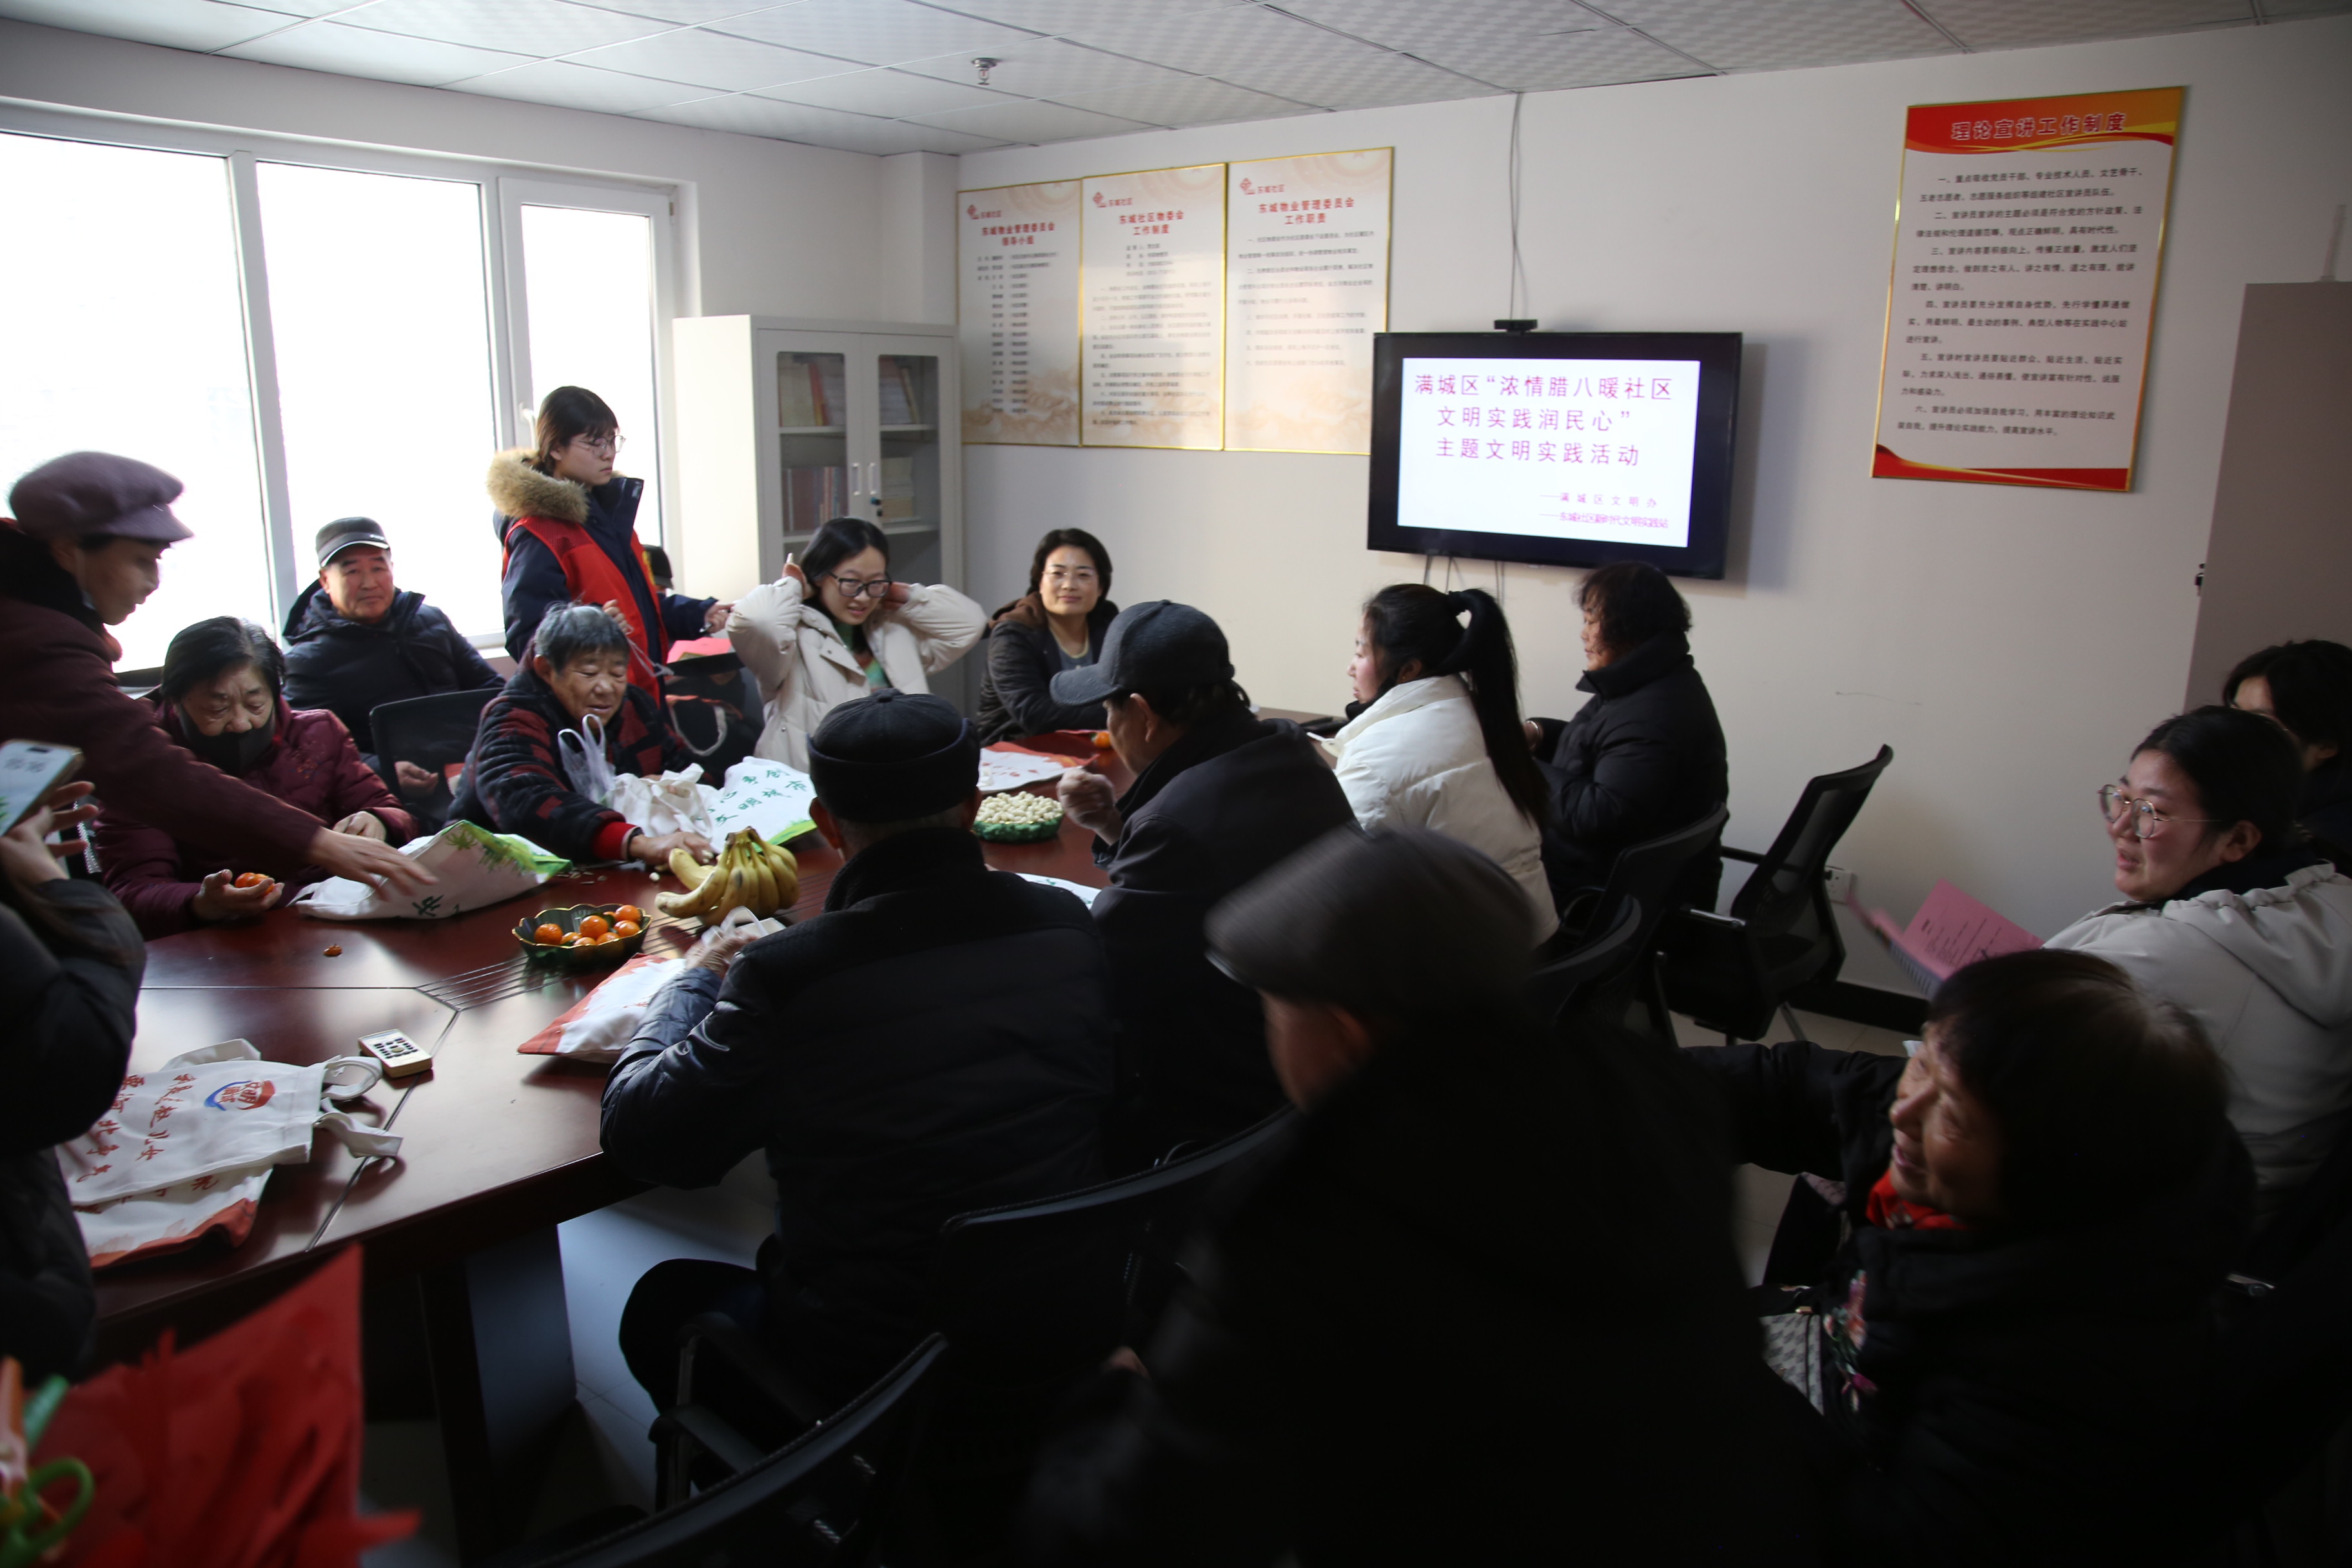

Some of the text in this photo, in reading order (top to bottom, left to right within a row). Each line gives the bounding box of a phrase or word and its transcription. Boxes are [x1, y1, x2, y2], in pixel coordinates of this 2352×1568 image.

[1951, 112, 2126, 141] 理论宣讲工作制度
[1259, 197, 1355, 213] 东城物业管理委员会
[1133, 224, 1170, 235] 工作制度
[1285, 213, 1326, 225] 工作职责
[1415, 375, 1672, 400] 满城区“浓情腊八暖社区
[1437, 406, 1631, 432] 文明实践润民心”
[1436, 438, 1639, 466] 主题文明实践活动
